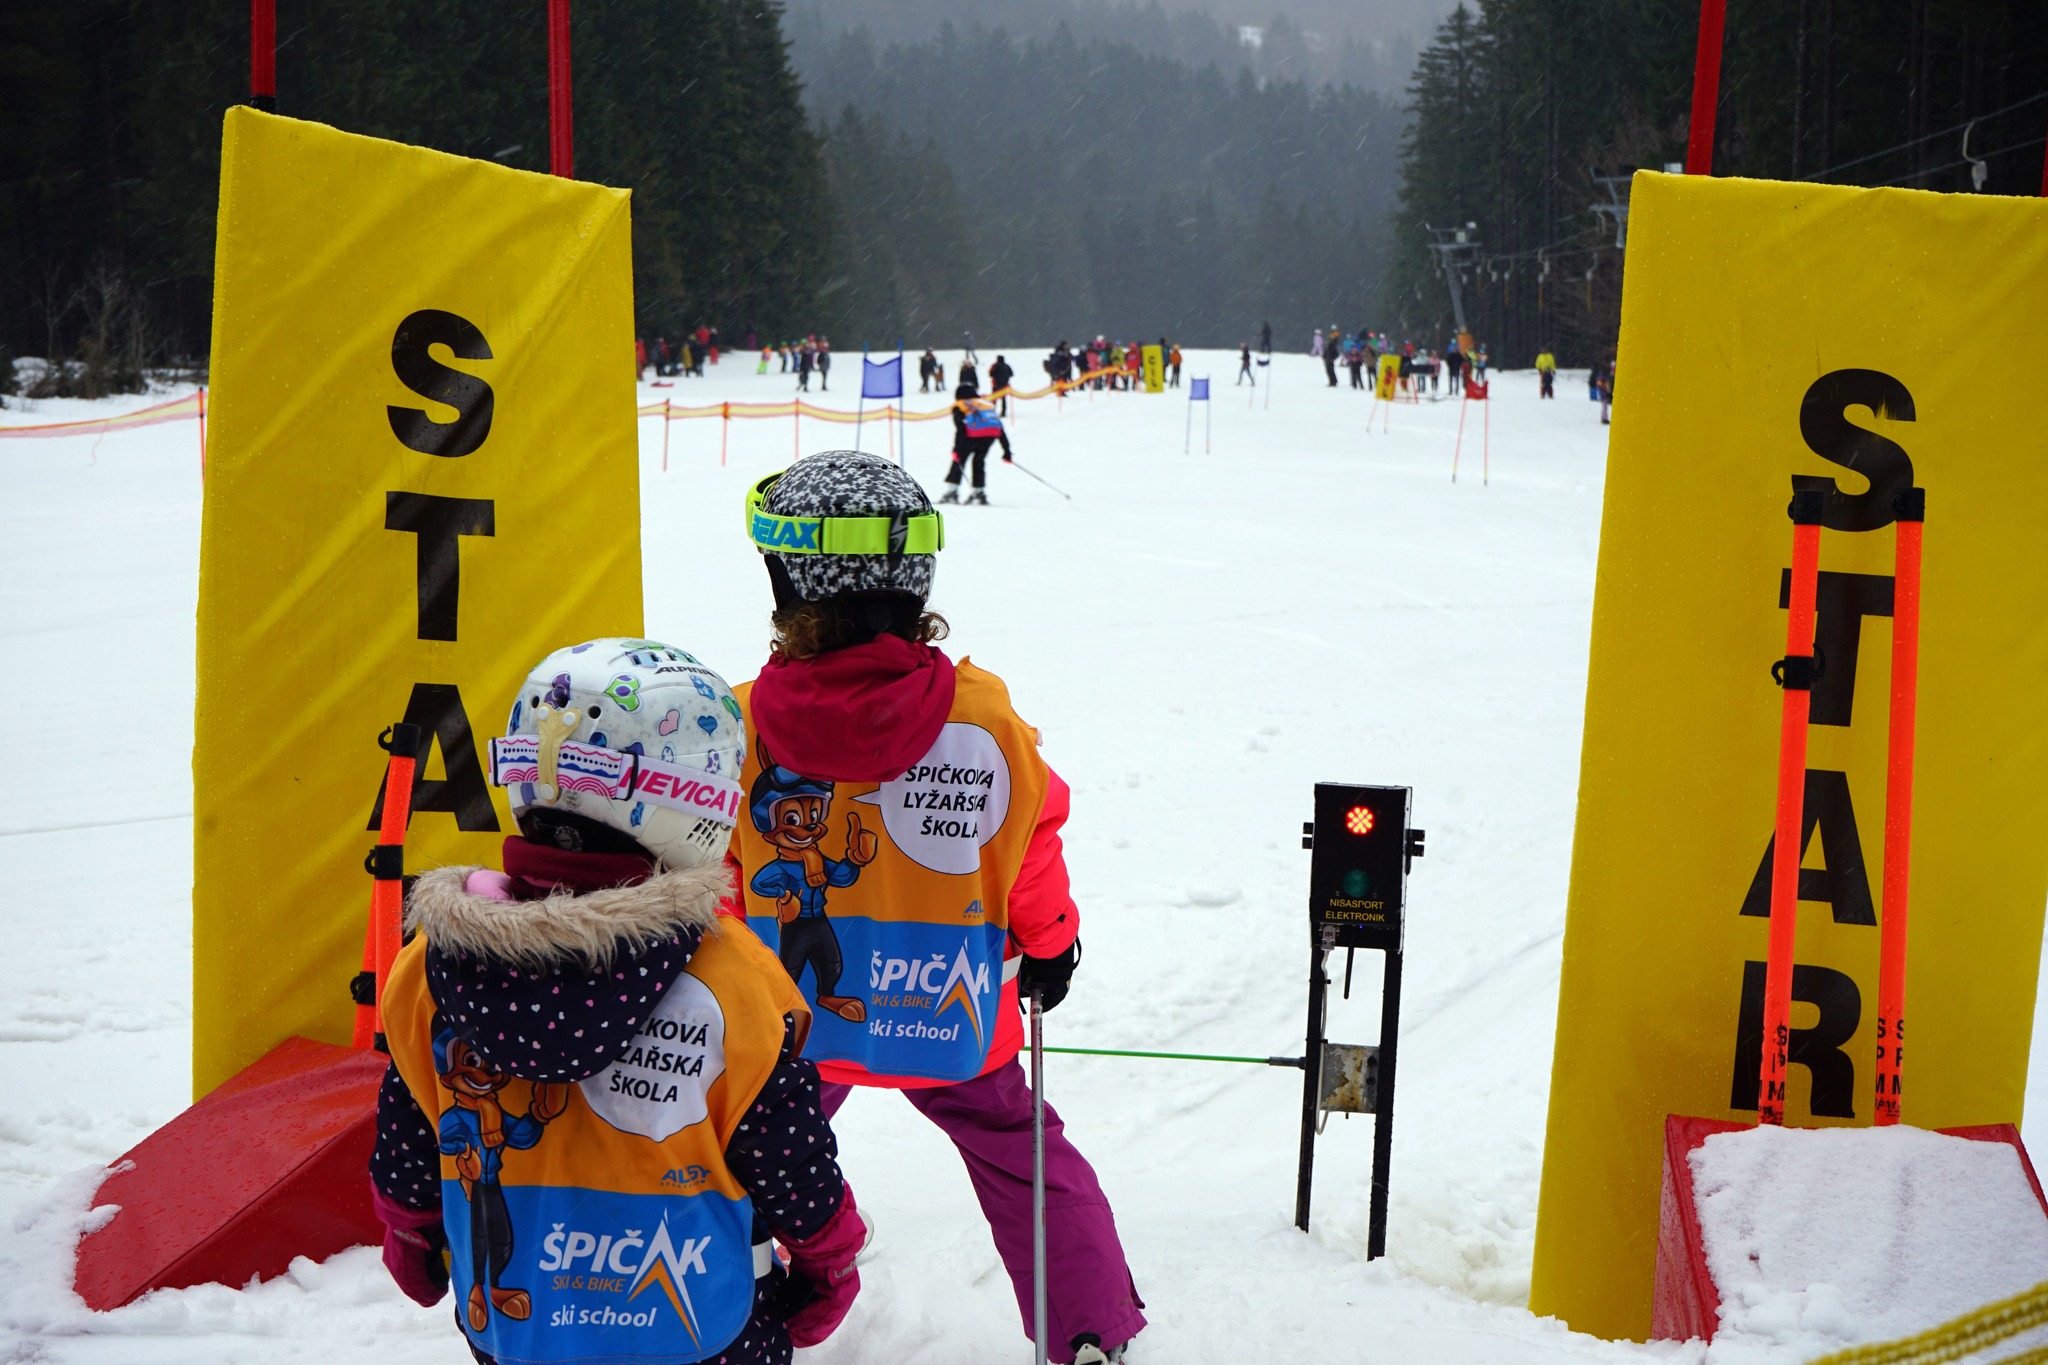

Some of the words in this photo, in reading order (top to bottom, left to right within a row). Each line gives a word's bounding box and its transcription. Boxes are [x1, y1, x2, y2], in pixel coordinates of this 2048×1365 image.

[752, 514, 820, 549] RELAX
[367, 309, 501, 947] STA
[1730, 367, 1917, 1118] STAR
[618, 767, 726, 811] NEVICA
[903, 789, 989, 812] LYŽAŘSÁ
[1330, 899, 1384, 910] NISASPORT
[1325, 911, 1385, 922] ELEKTRONIK
[871, 993, 889, 1006] SKI
[890, 995, 899, 1007] &
[902, 995, 934, 1009] BIKE
[636, 1017, 709, 1047] KOVÁ
[869, 1019, 893, 1036] ski
[895, 1021, 960, 1041] school
[609, 1070, 678, 1103] ŠKOLA
[552, 1275, 570, 1291] SKI
[571, 1276, 585, 1290] &
[587, 1277, 627, 1293] BIKE
[550, 1304, 575, 1327] ski
[578, 1306, 657, 1327] school
